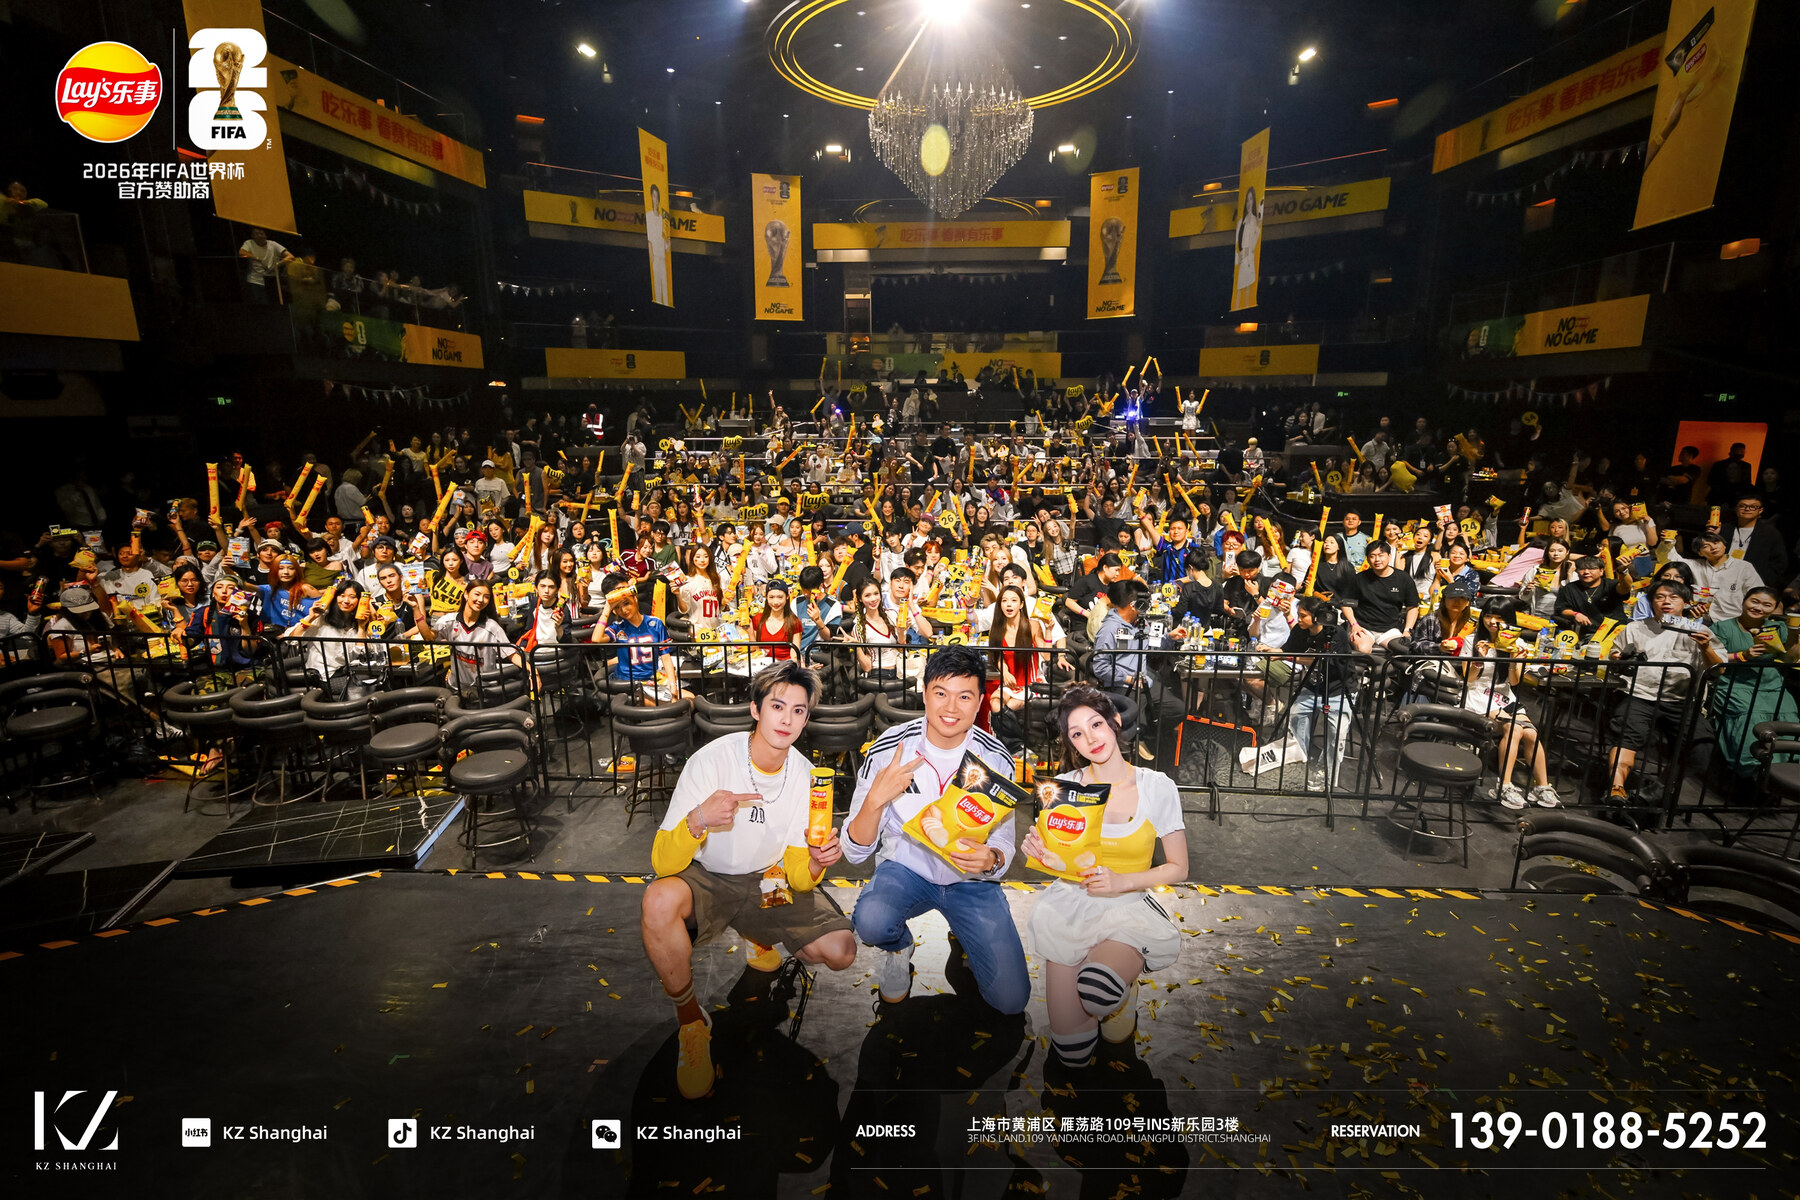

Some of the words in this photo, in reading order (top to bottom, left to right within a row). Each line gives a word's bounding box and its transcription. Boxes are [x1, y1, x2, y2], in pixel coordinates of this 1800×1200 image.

[1299, 192, 1350, 212] GAME
[594, 207, 617, 222] NO
[1106, 304, 1126, 312] GAME
[1558, 316, 1576, 332] NO
[437, 337, 448, 348] NO
[1545, 331, 1565, 347] NO
[1563, 328, 1599, 345] GAME
[432, 348, 443, 360] NO
[443, 350, 463, 362] GAME
[989, 359, 1004, 368] NO
[1329, 473, 1340, 483] 33
[803, 495, 827, 509] Lay's
[941, 514, 954, 526] 26
[1461, 521, 1478, 533] 24
[137, 586, 148, 595] 63
[700, 632, 711, 641] 05
[1561, 633, 1575, 645] 02
